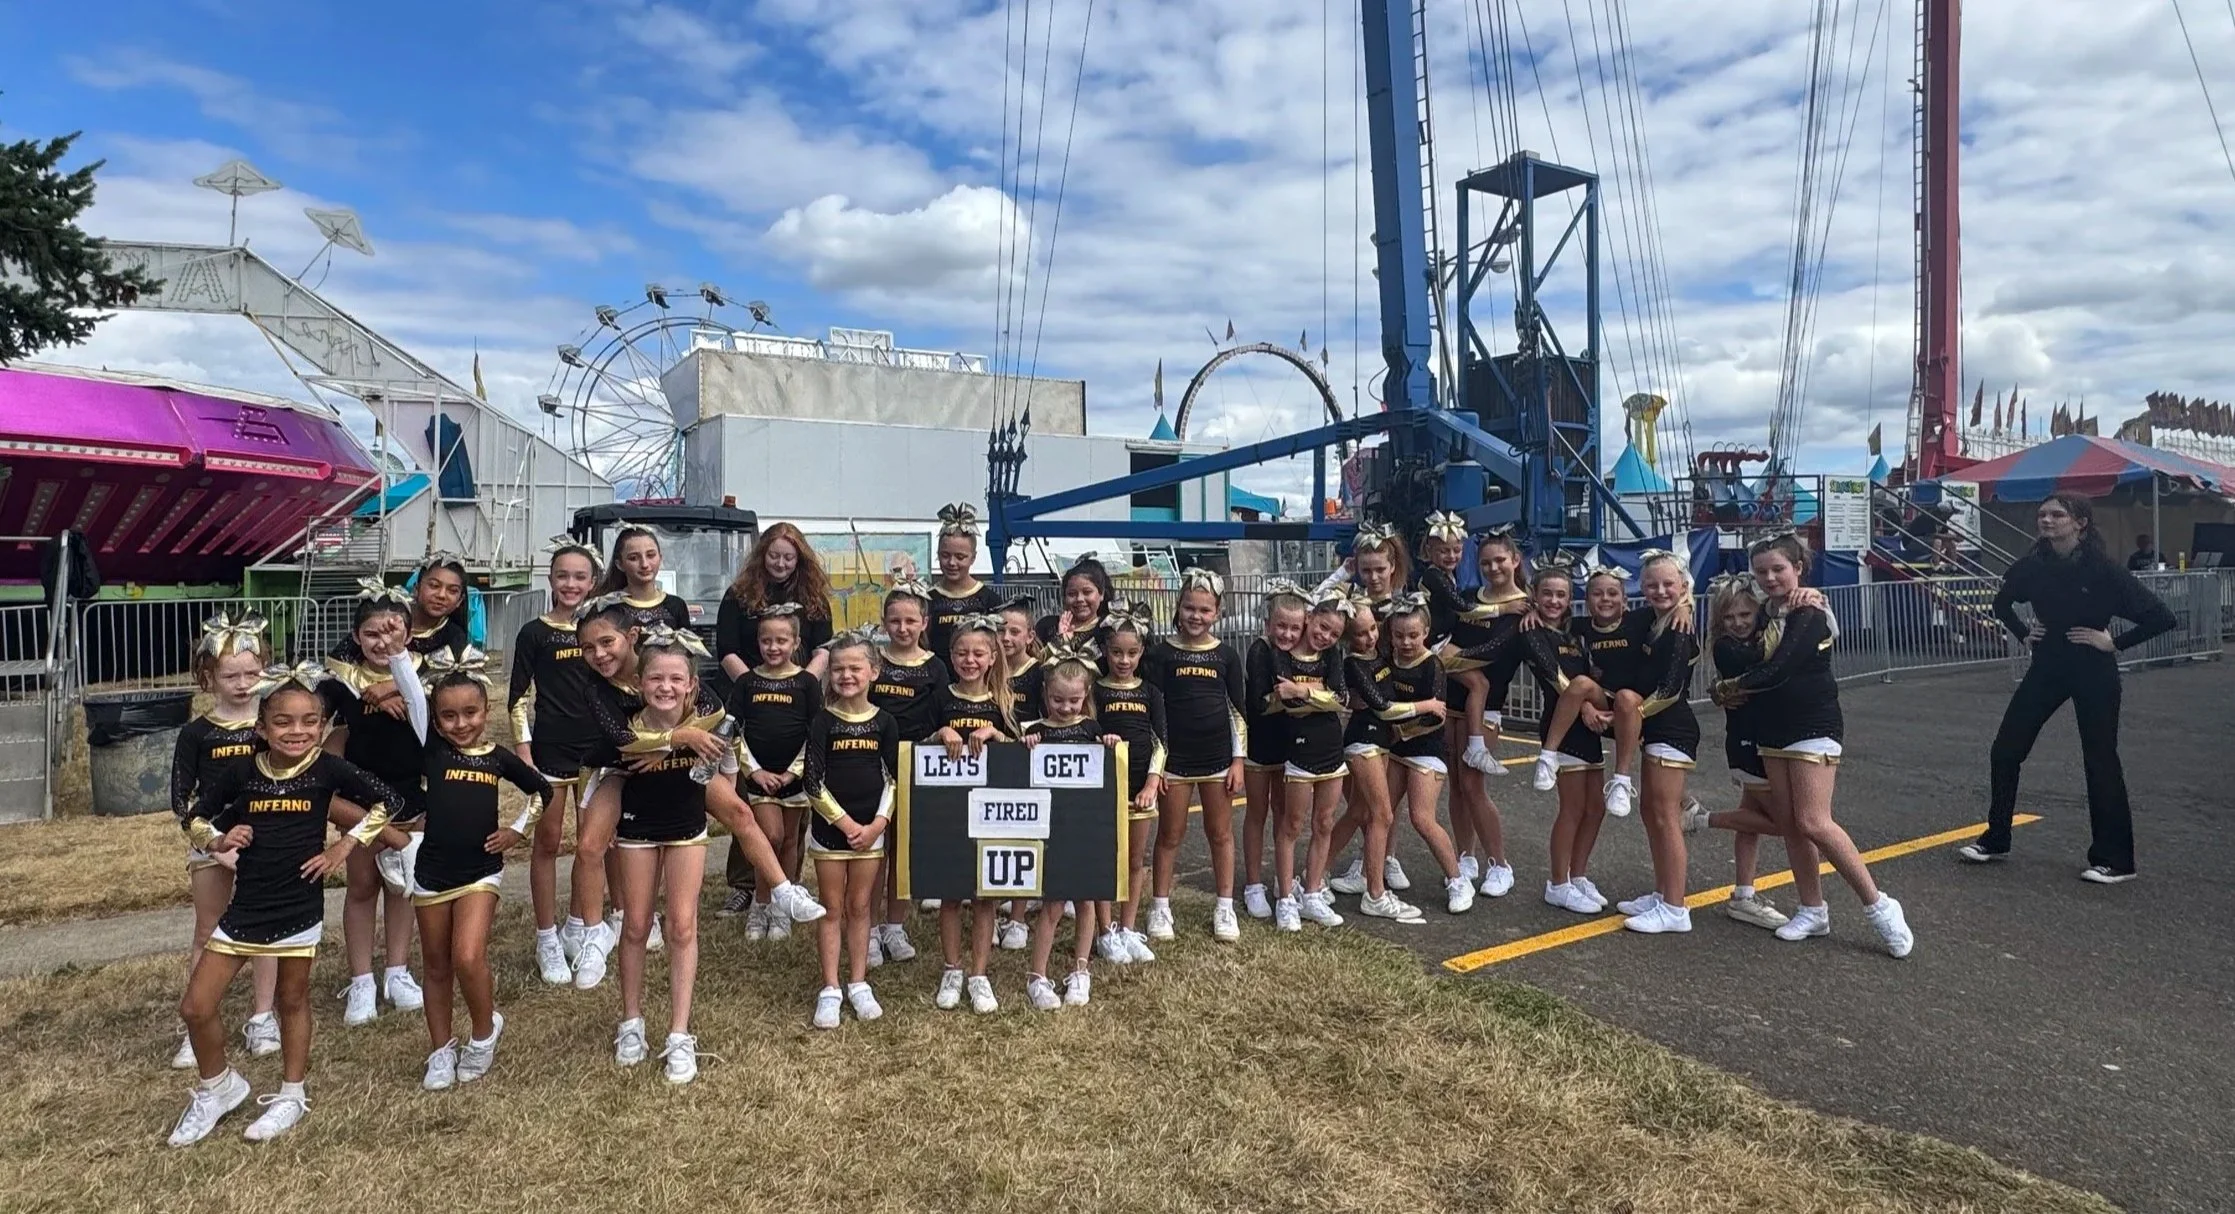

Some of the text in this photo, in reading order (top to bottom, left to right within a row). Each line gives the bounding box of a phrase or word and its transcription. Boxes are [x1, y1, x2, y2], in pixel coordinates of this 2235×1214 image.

[1176, 666, 1218, 679] INFERNO
[875, 684, 915, 697] INFERNO
[752, 693, 793, 704] INFERNO
[1105, 702, 1147, 713] INFERNO
[212, 745, 251, 759] INFER
[832, 739, 879, 751] INFERNO
[924, 754, 1089, 778] LETS GET
[444, 769, 497, 786] INFERNO
[248, 799, 312, 813] INFERNO
[984, 802, 1038, 821] FIRED
[987, 850, 1035, 886] UP
